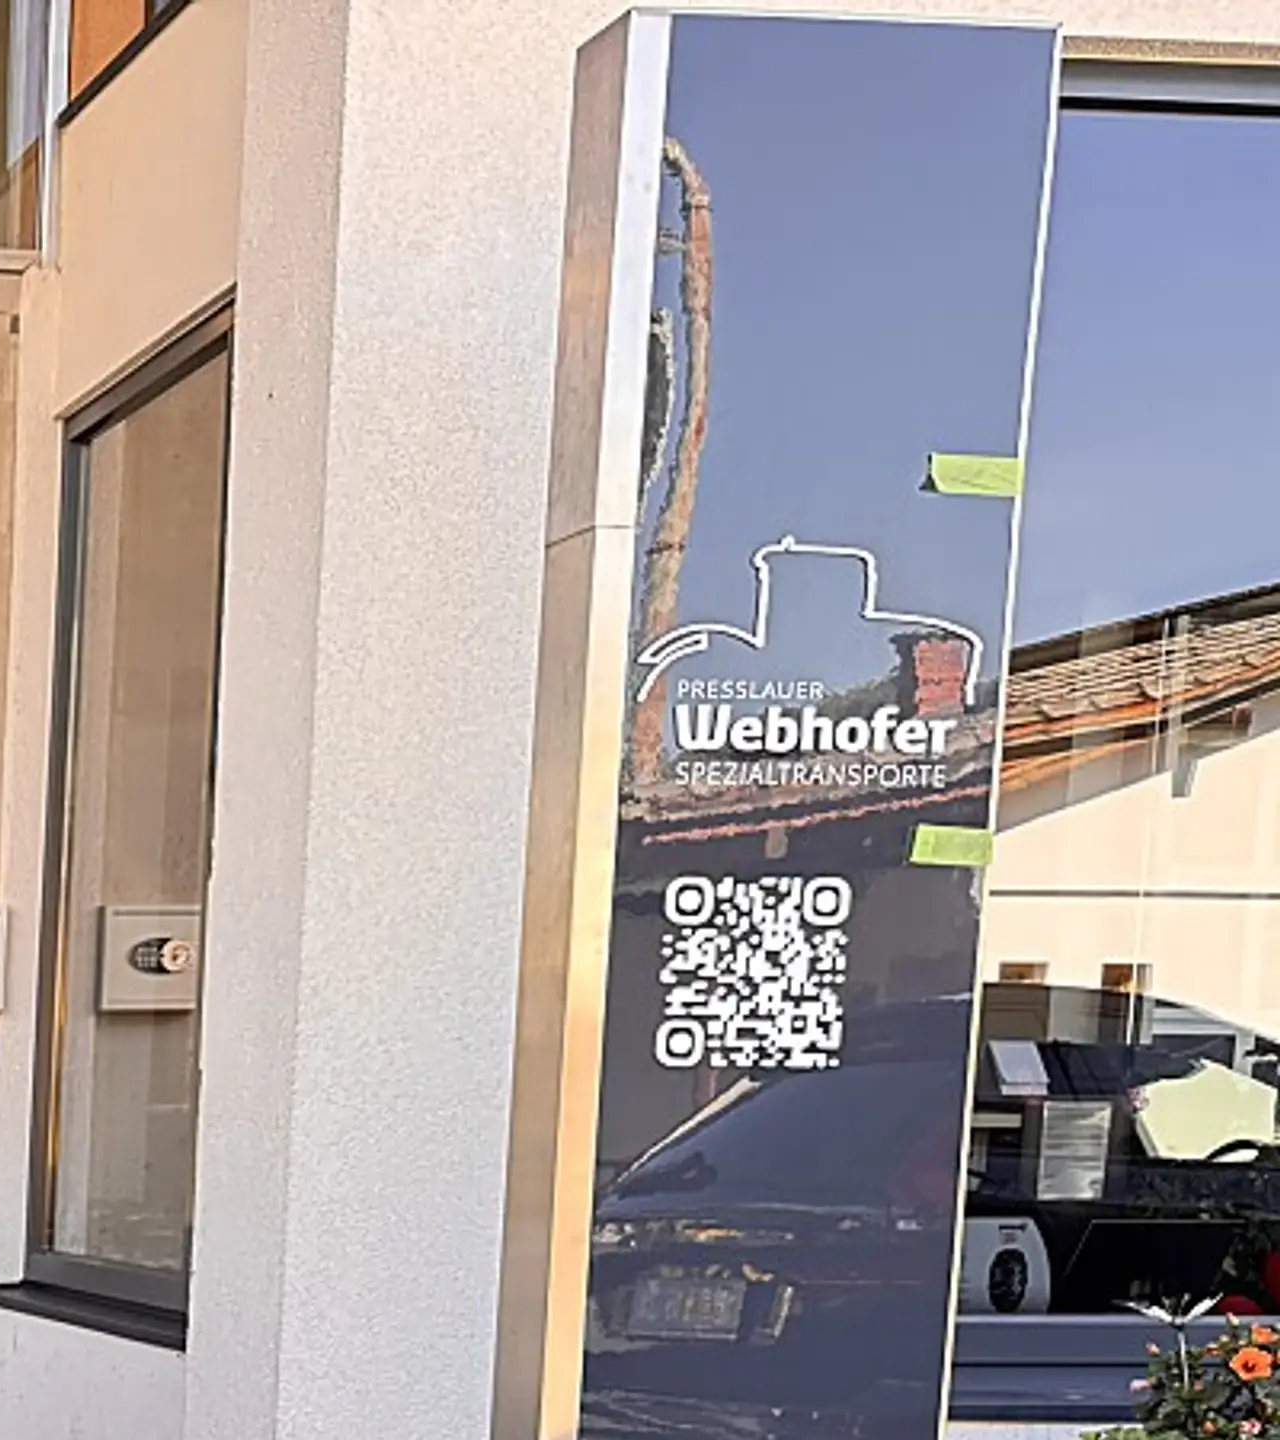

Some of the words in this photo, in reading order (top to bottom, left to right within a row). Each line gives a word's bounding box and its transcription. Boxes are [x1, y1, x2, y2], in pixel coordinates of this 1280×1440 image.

[676, 679, 825, 700] PRESSLAUER
[675, 703, 958, 756] Webhofer
[674, 761, 949, 789] SPEZIALTRANSPORTE
